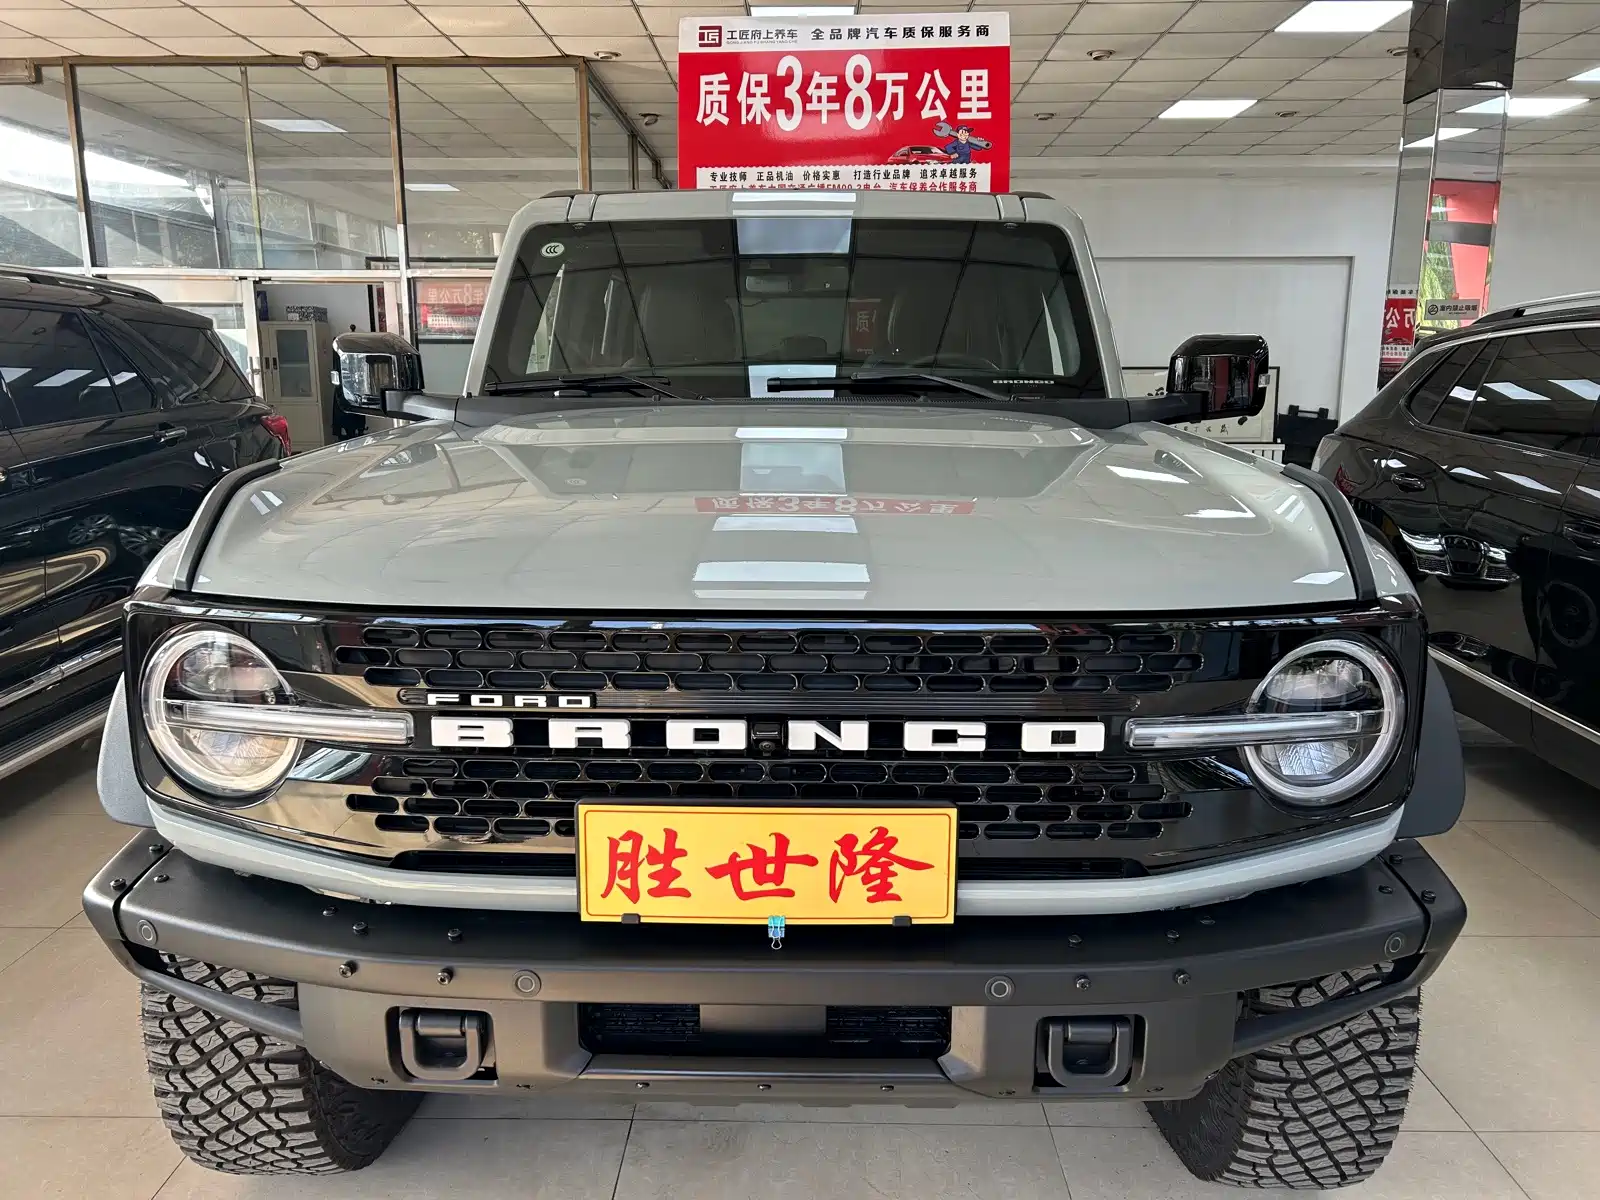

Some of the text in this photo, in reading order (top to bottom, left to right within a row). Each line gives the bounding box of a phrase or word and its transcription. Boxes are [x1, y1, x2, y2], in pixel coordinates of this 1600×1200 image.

[727, 29, 798, 40] 工匠府上养车
[811, 25, 990, 41] 全品牌汽车质保服务商
[696, 53, 992, 132] 质保3年8万公里
[709, 168, 977, 182] 专业技师 正品机油 价格实惠 打造行业品牌 追求卓越服务
[427, 693, 591, 708] FORD
[431, 716, 1105, 753] BRONCO
[600, 826, 935, 904] 胜世隆
